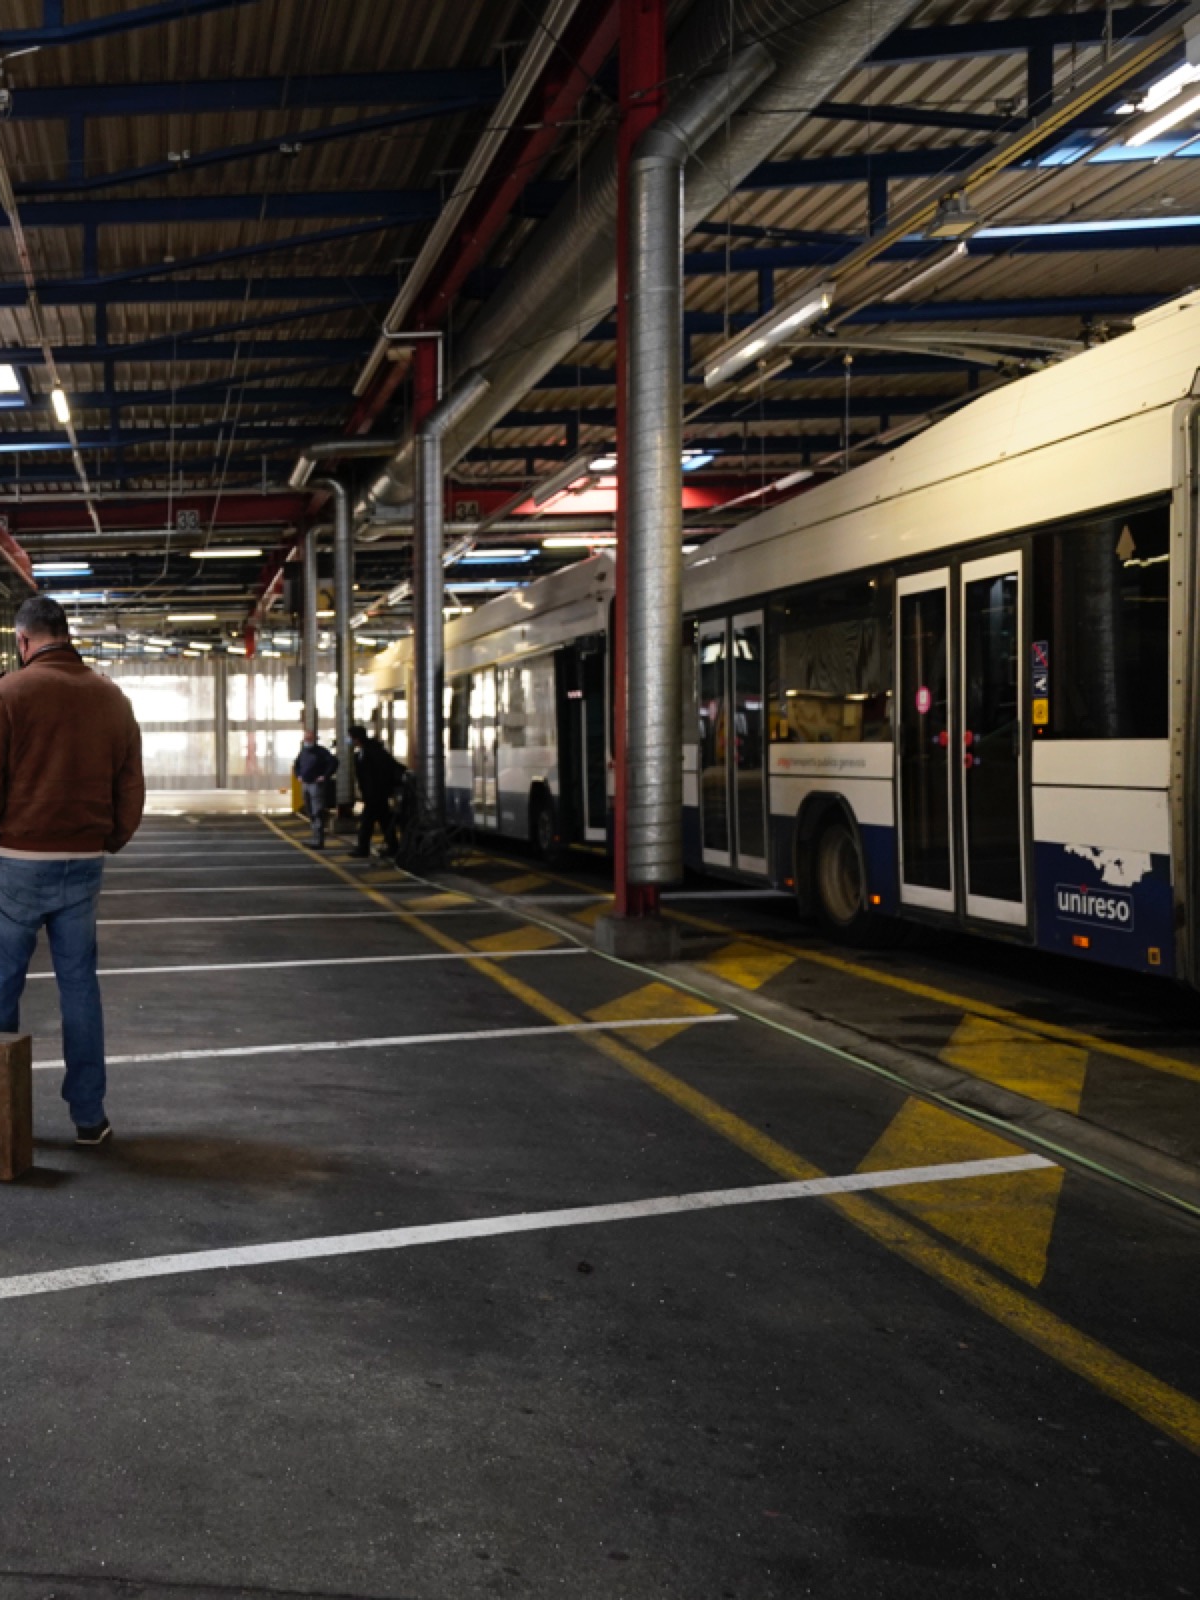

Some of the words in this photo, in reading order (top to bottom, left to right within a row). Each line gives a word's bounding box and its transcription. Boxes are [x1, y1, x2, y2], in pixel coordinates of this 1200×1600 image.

[177, 512, 197, 529] 33
[458, 503, 477, 521] 34
[1057, 884, 1130, 922] unireso
